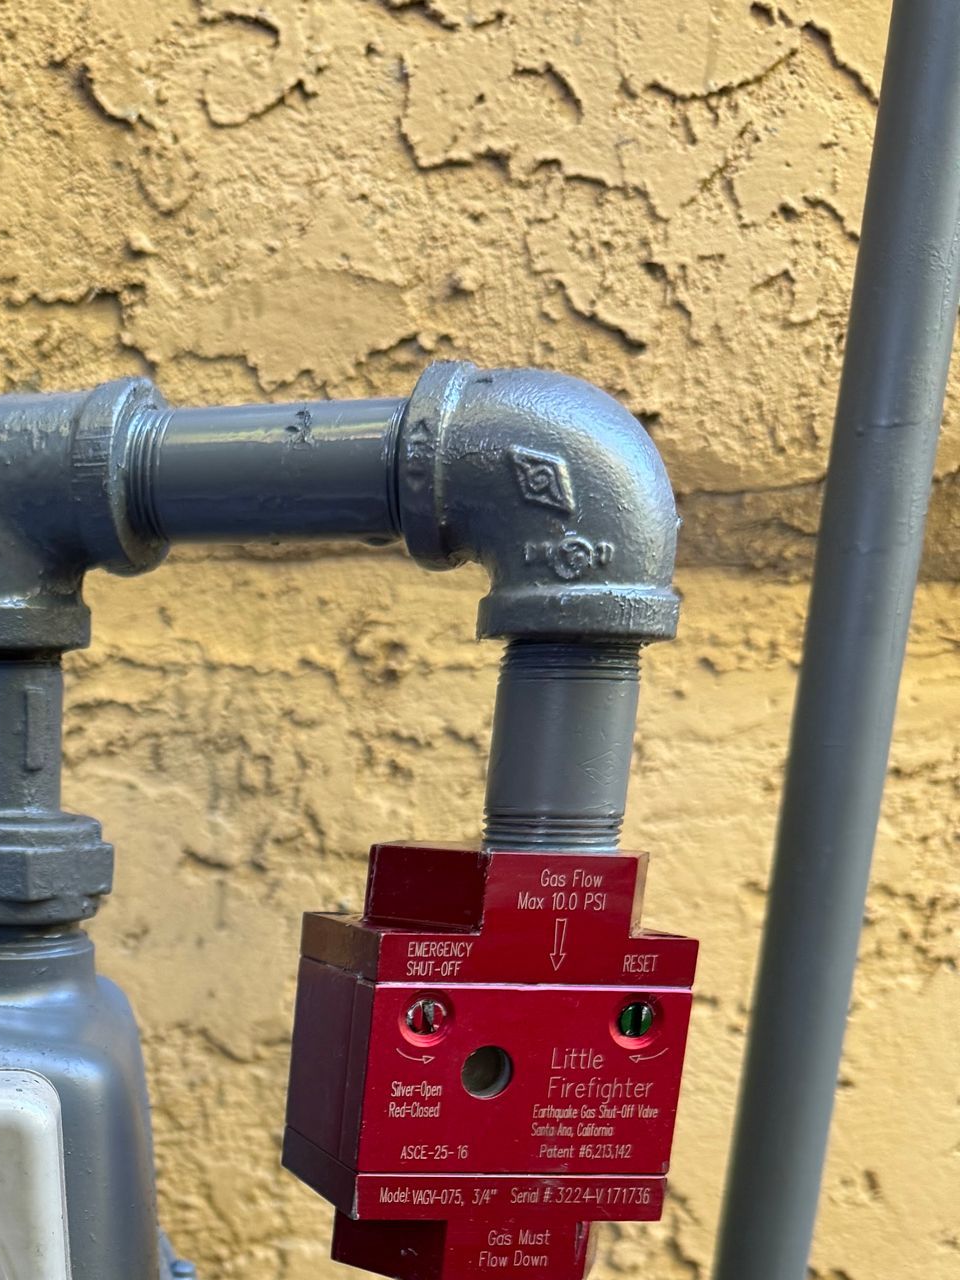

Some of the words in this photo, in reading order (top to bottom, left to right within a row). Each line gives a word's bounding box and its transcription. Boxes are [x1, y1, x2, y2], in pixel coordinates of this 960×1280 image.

[540, 869, 567, 888] Gas
[572, 870, 603, 888] Flow
[517, 892, 544, 911] Max
[551, 892, 578, 911] 10.0
[584, 893, 607, 911] PSI
[407, 941, 474, 958] EMERGENCY
[406, 960, 462, 977] SHUT-OFF
[623, 954, 659, 973] RESET
[551, 1047, 604, 1070] Little
[547, 1076, 654, 1105] Firefighter
[533, 1104, 578, 1122] Earthquake
[580, 1105, 596, 1119] Gas
[598, 1104, 635, 1119] Shut-Off
[638, 1105, 659, 1119] Valve
[531, 1122, 555, 1137] Santa
[557, 1123, 574, 1138] Ana,
[577, 1122, 614, 1137] California
[539, 1144, 575, 1159] Patent
[578, 1144, 632, 1159] #6,213,142
[379, 1187, 410, 1203] Model:
[412, 1189, 464, 1206] VAGV-075,
[510, 1187, 539, 1204] Serial
[488, 1230, 512, 1246] Gas
[518, 1230, 551, 1246] Must
[478, 1251, 507, 1267] Flow
[513, 1250, 548, 1267] Down
